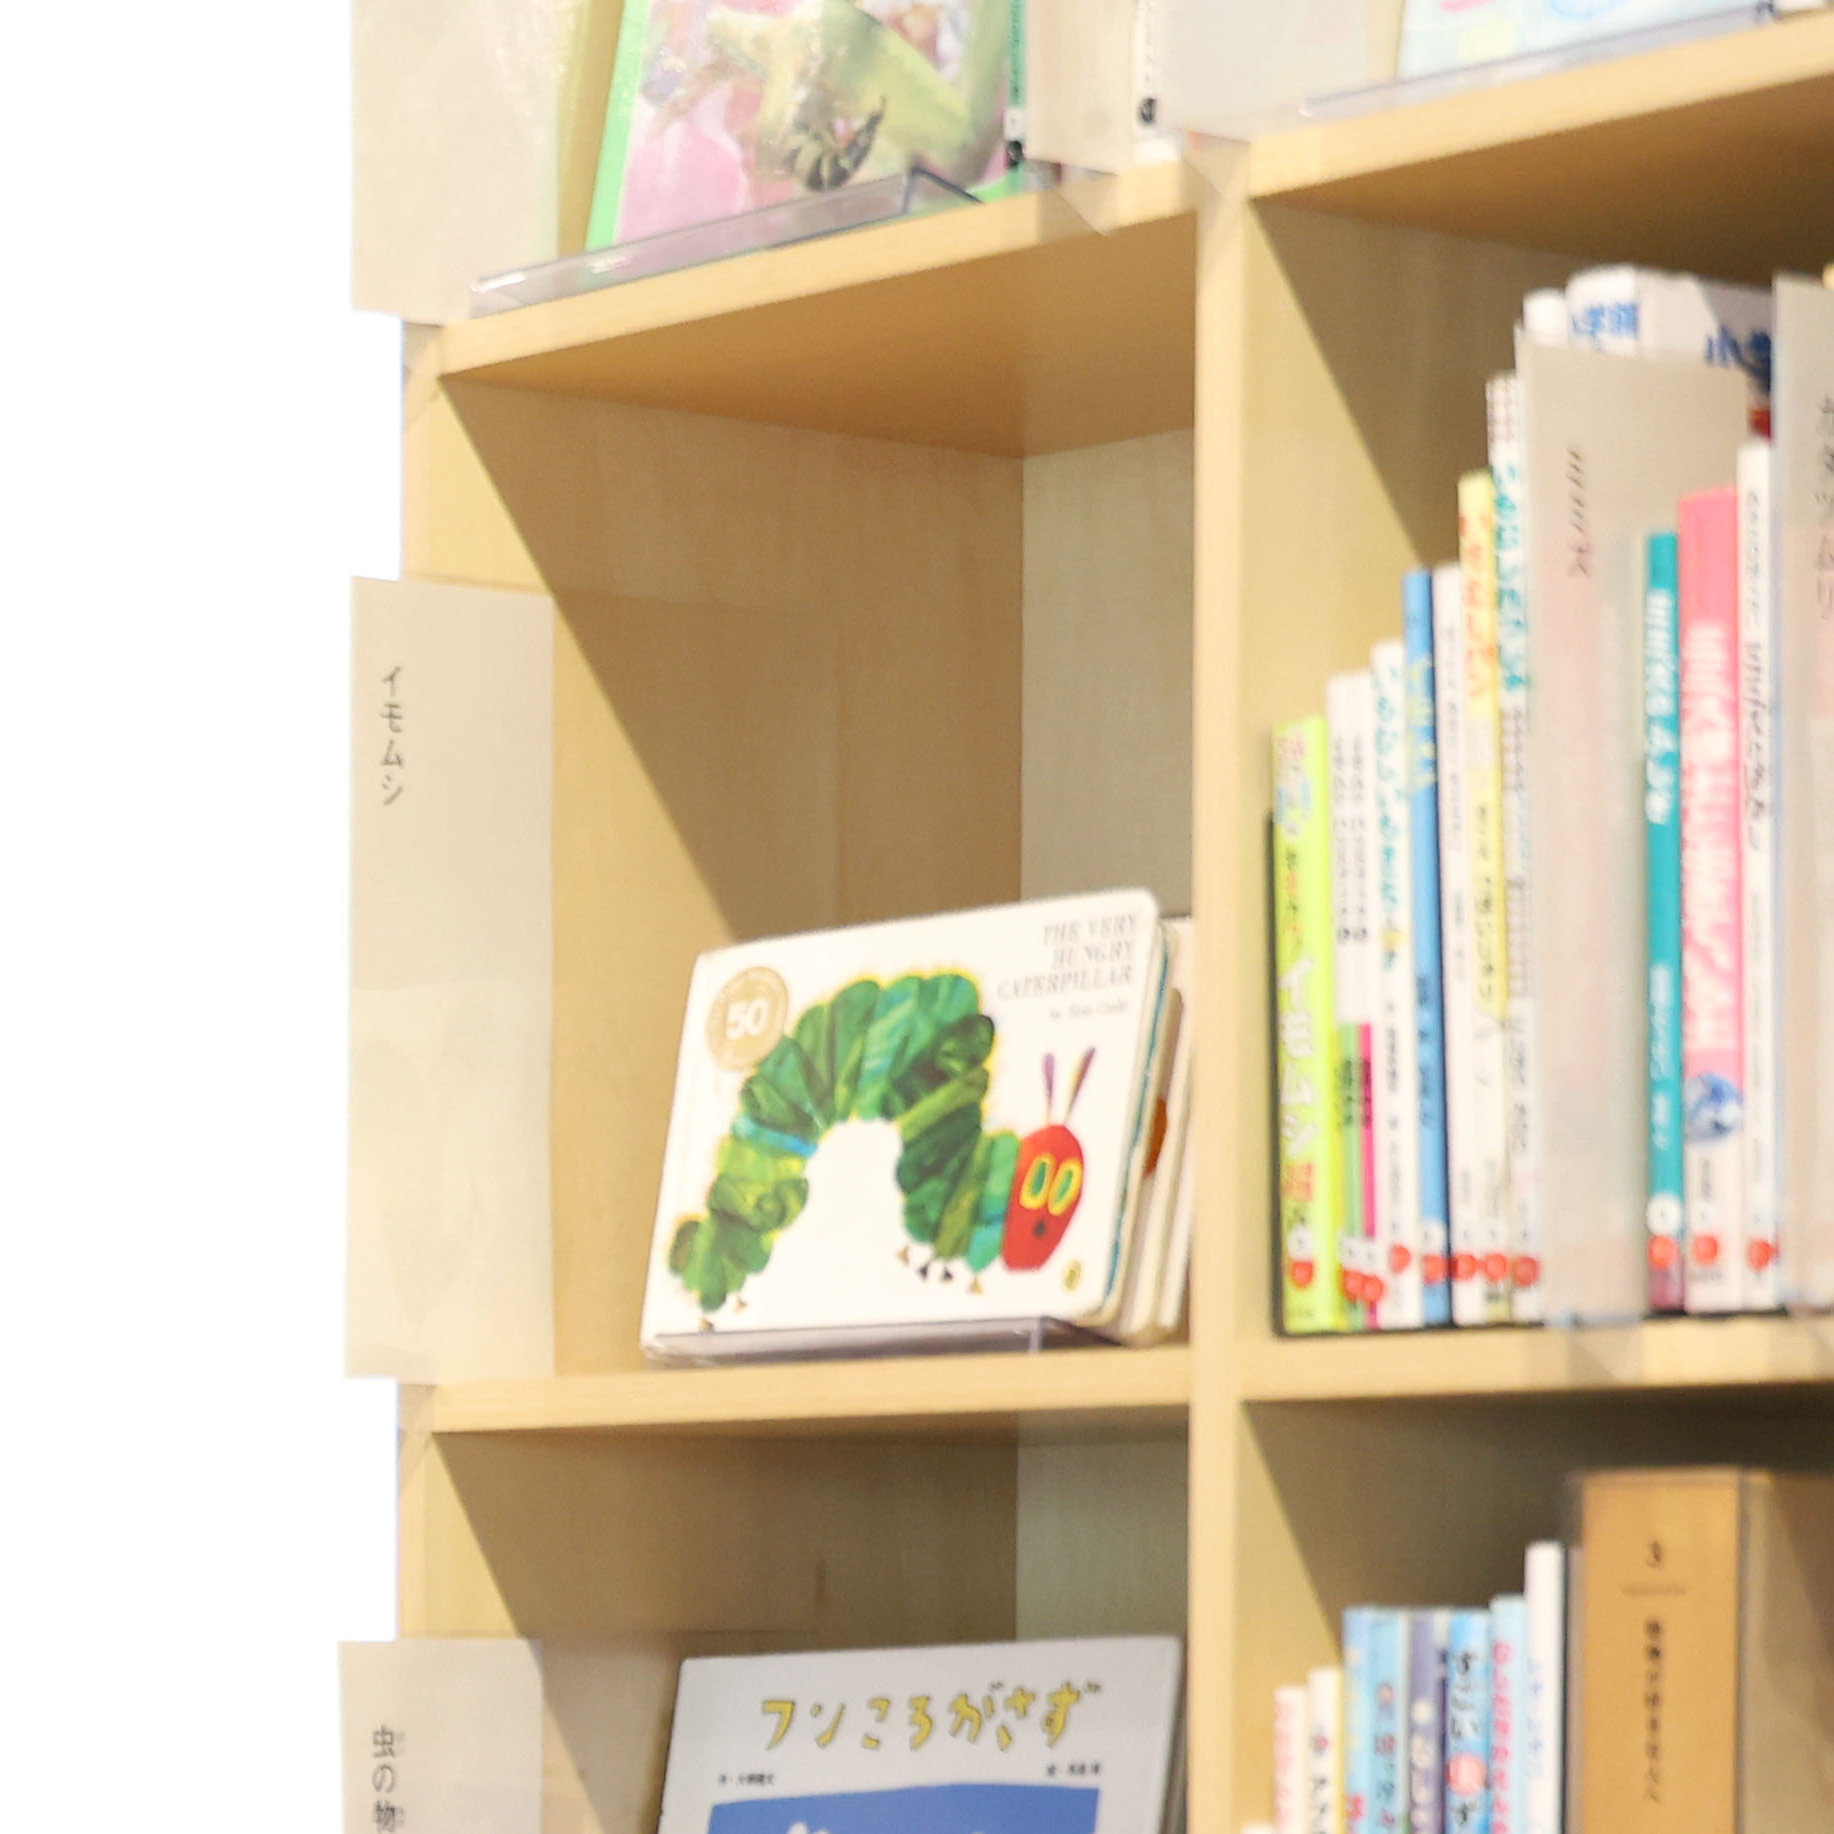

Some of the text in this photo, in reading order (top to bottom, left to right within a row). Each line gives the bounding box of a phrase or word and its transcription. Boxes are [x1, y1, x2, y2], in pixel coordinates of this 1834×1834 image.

[380, 665, 405, 806] イモムシ
[1043, 914, 1139, 946] THE VERY
[1051, 941, 1135, 968] HUNGRY
[996, 966, 1132, 1001] CATERPILLAR
[725, 1000, 768, 1038] 50
[762, 1680, 1102, 1752] フンころがさず
